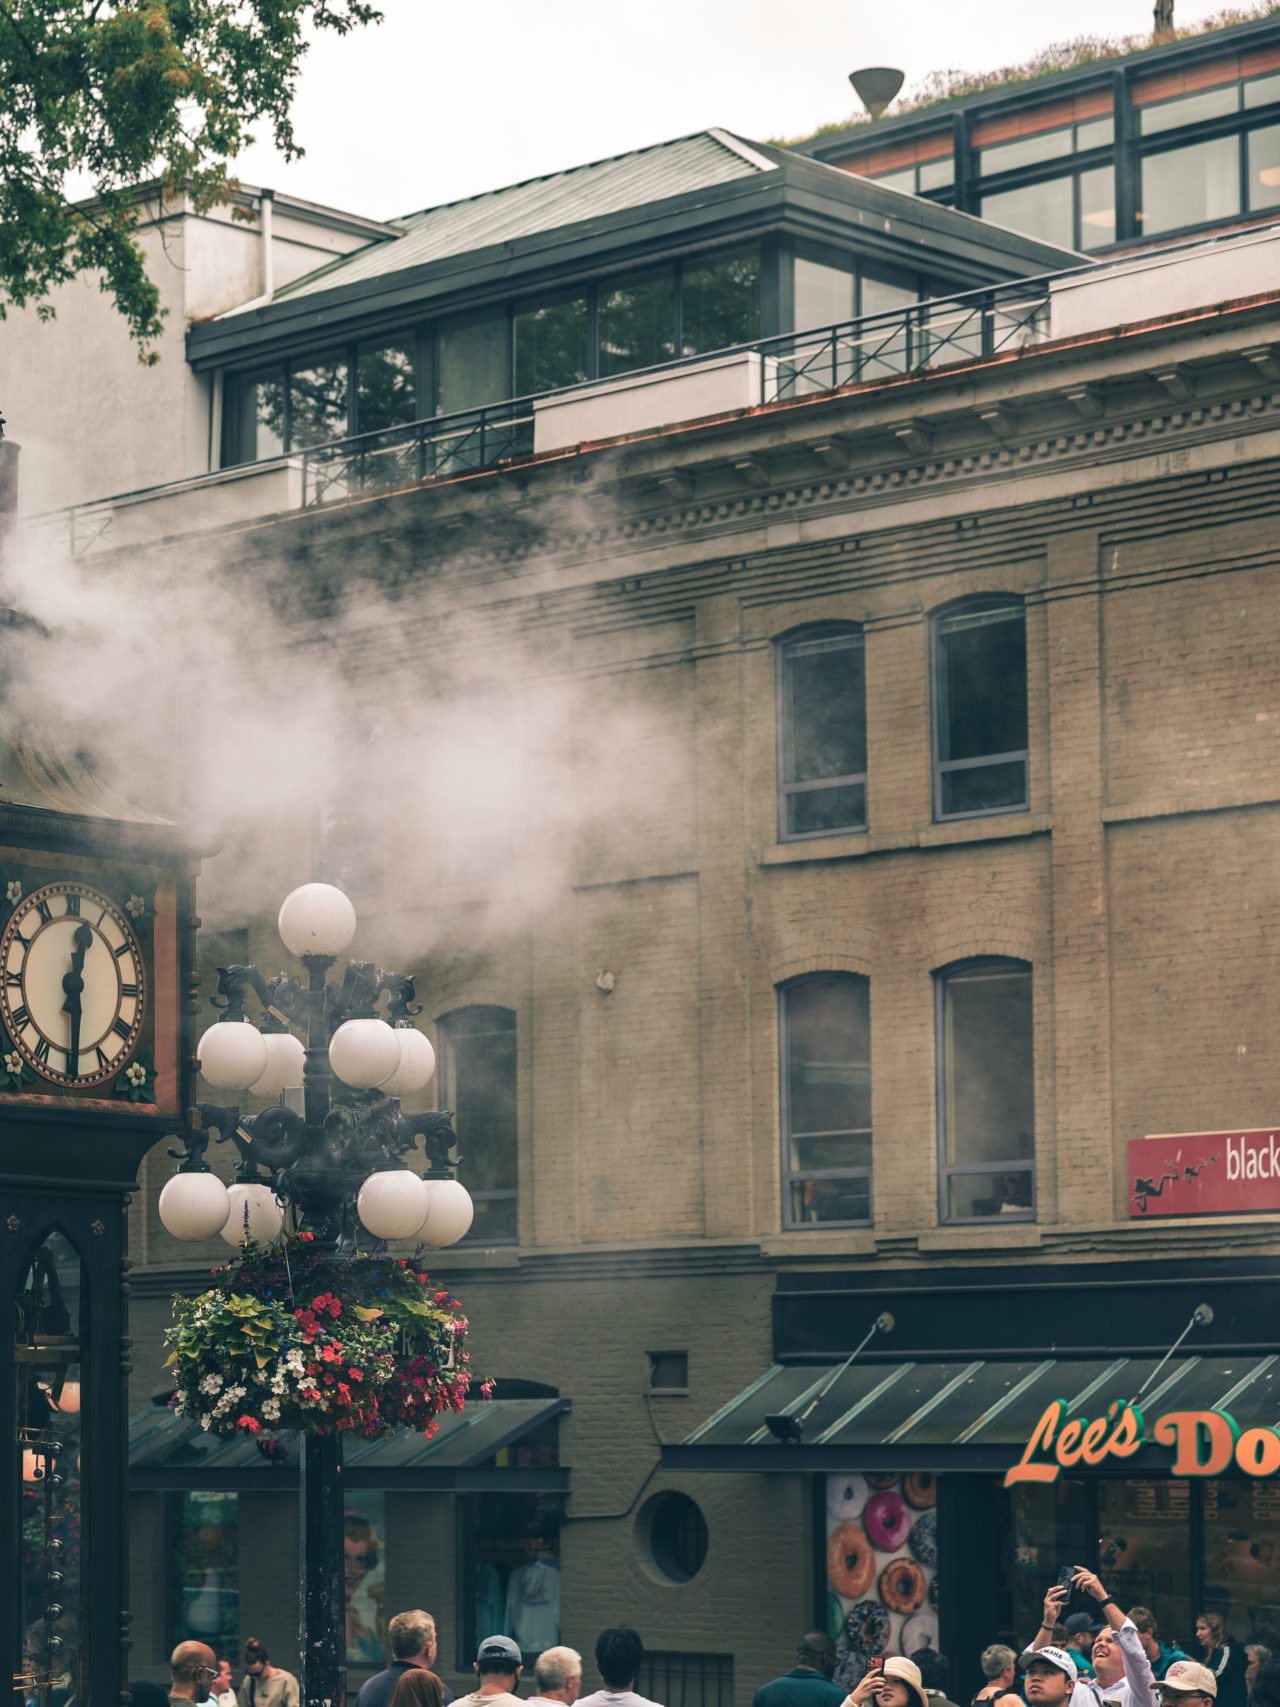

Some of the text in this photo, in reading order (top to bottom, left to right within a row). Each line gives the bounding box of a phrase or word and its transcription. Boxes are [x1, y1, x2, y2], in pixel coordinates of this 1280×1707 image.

[1226, 1134, 1280, 1180] black
[1003, 1398, 1280, 1488] Lee's Do
